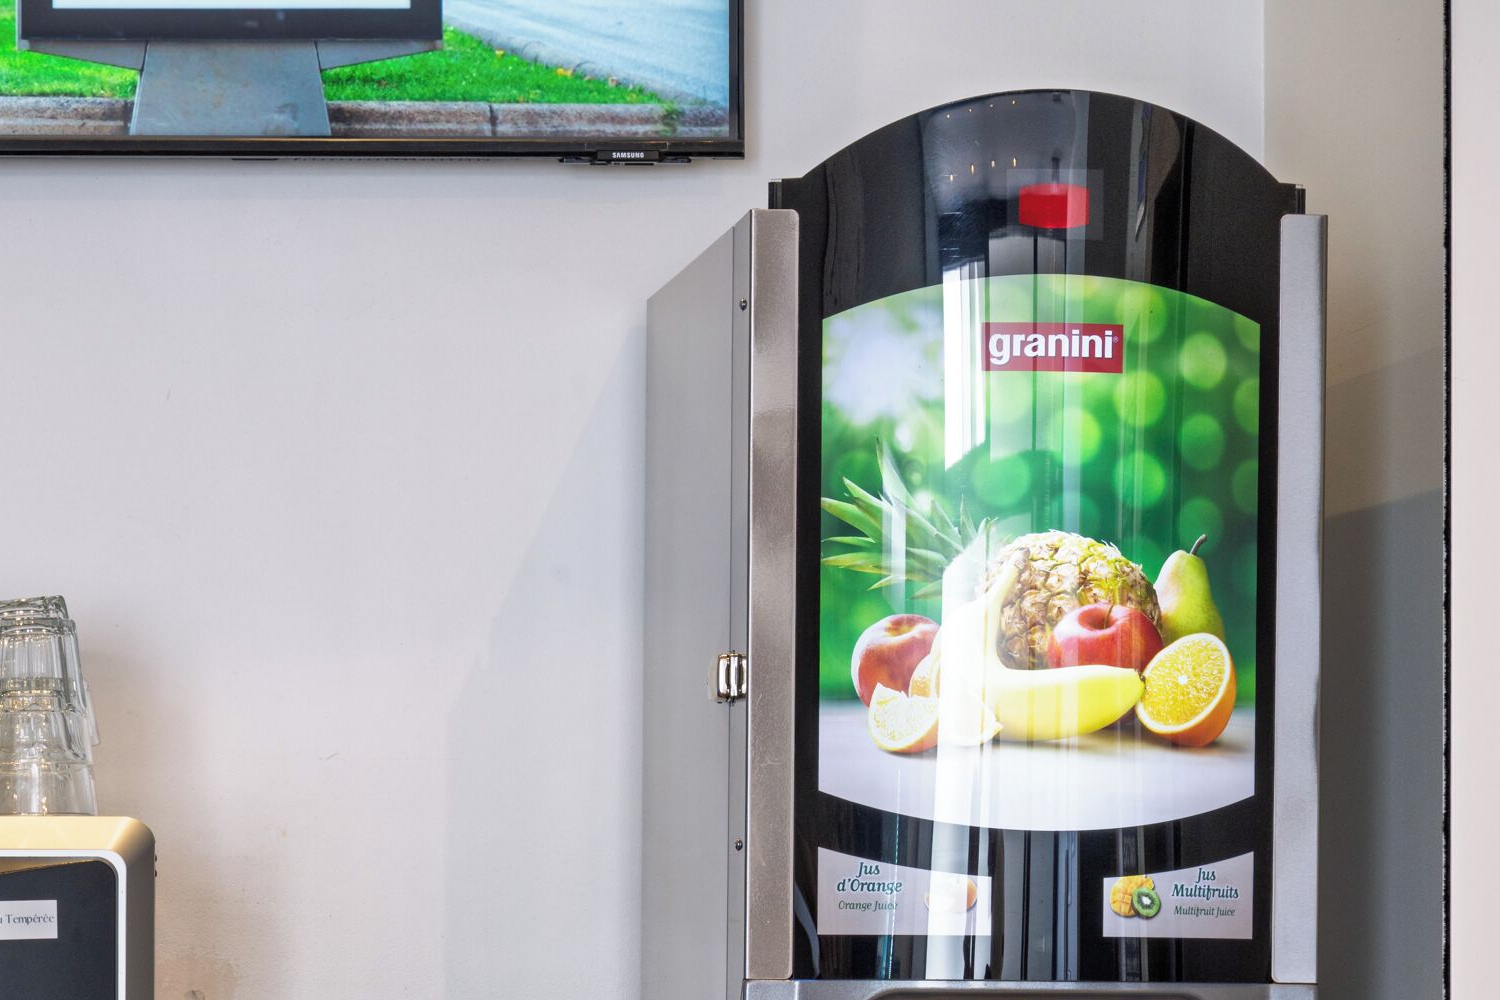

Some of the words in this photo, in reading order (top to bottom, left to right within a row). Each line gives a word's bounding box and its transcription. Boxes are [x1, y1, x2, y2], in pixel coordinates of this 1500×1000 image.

[988, 329, 1113, 366] granini
[856, 861, 881, 878] Jus
[1195, 867, 1216, 884] Jus
[1171, 883, 1239, 901] Multifruits
[838, 900, 873, 912] Orange
[873, 900, 898, 912] Juice
[1173, 905, 1215, 918] Multifruit
[1215, 906, 1236, 918] Juice
[5, 913, 54, 926] Tempérée
